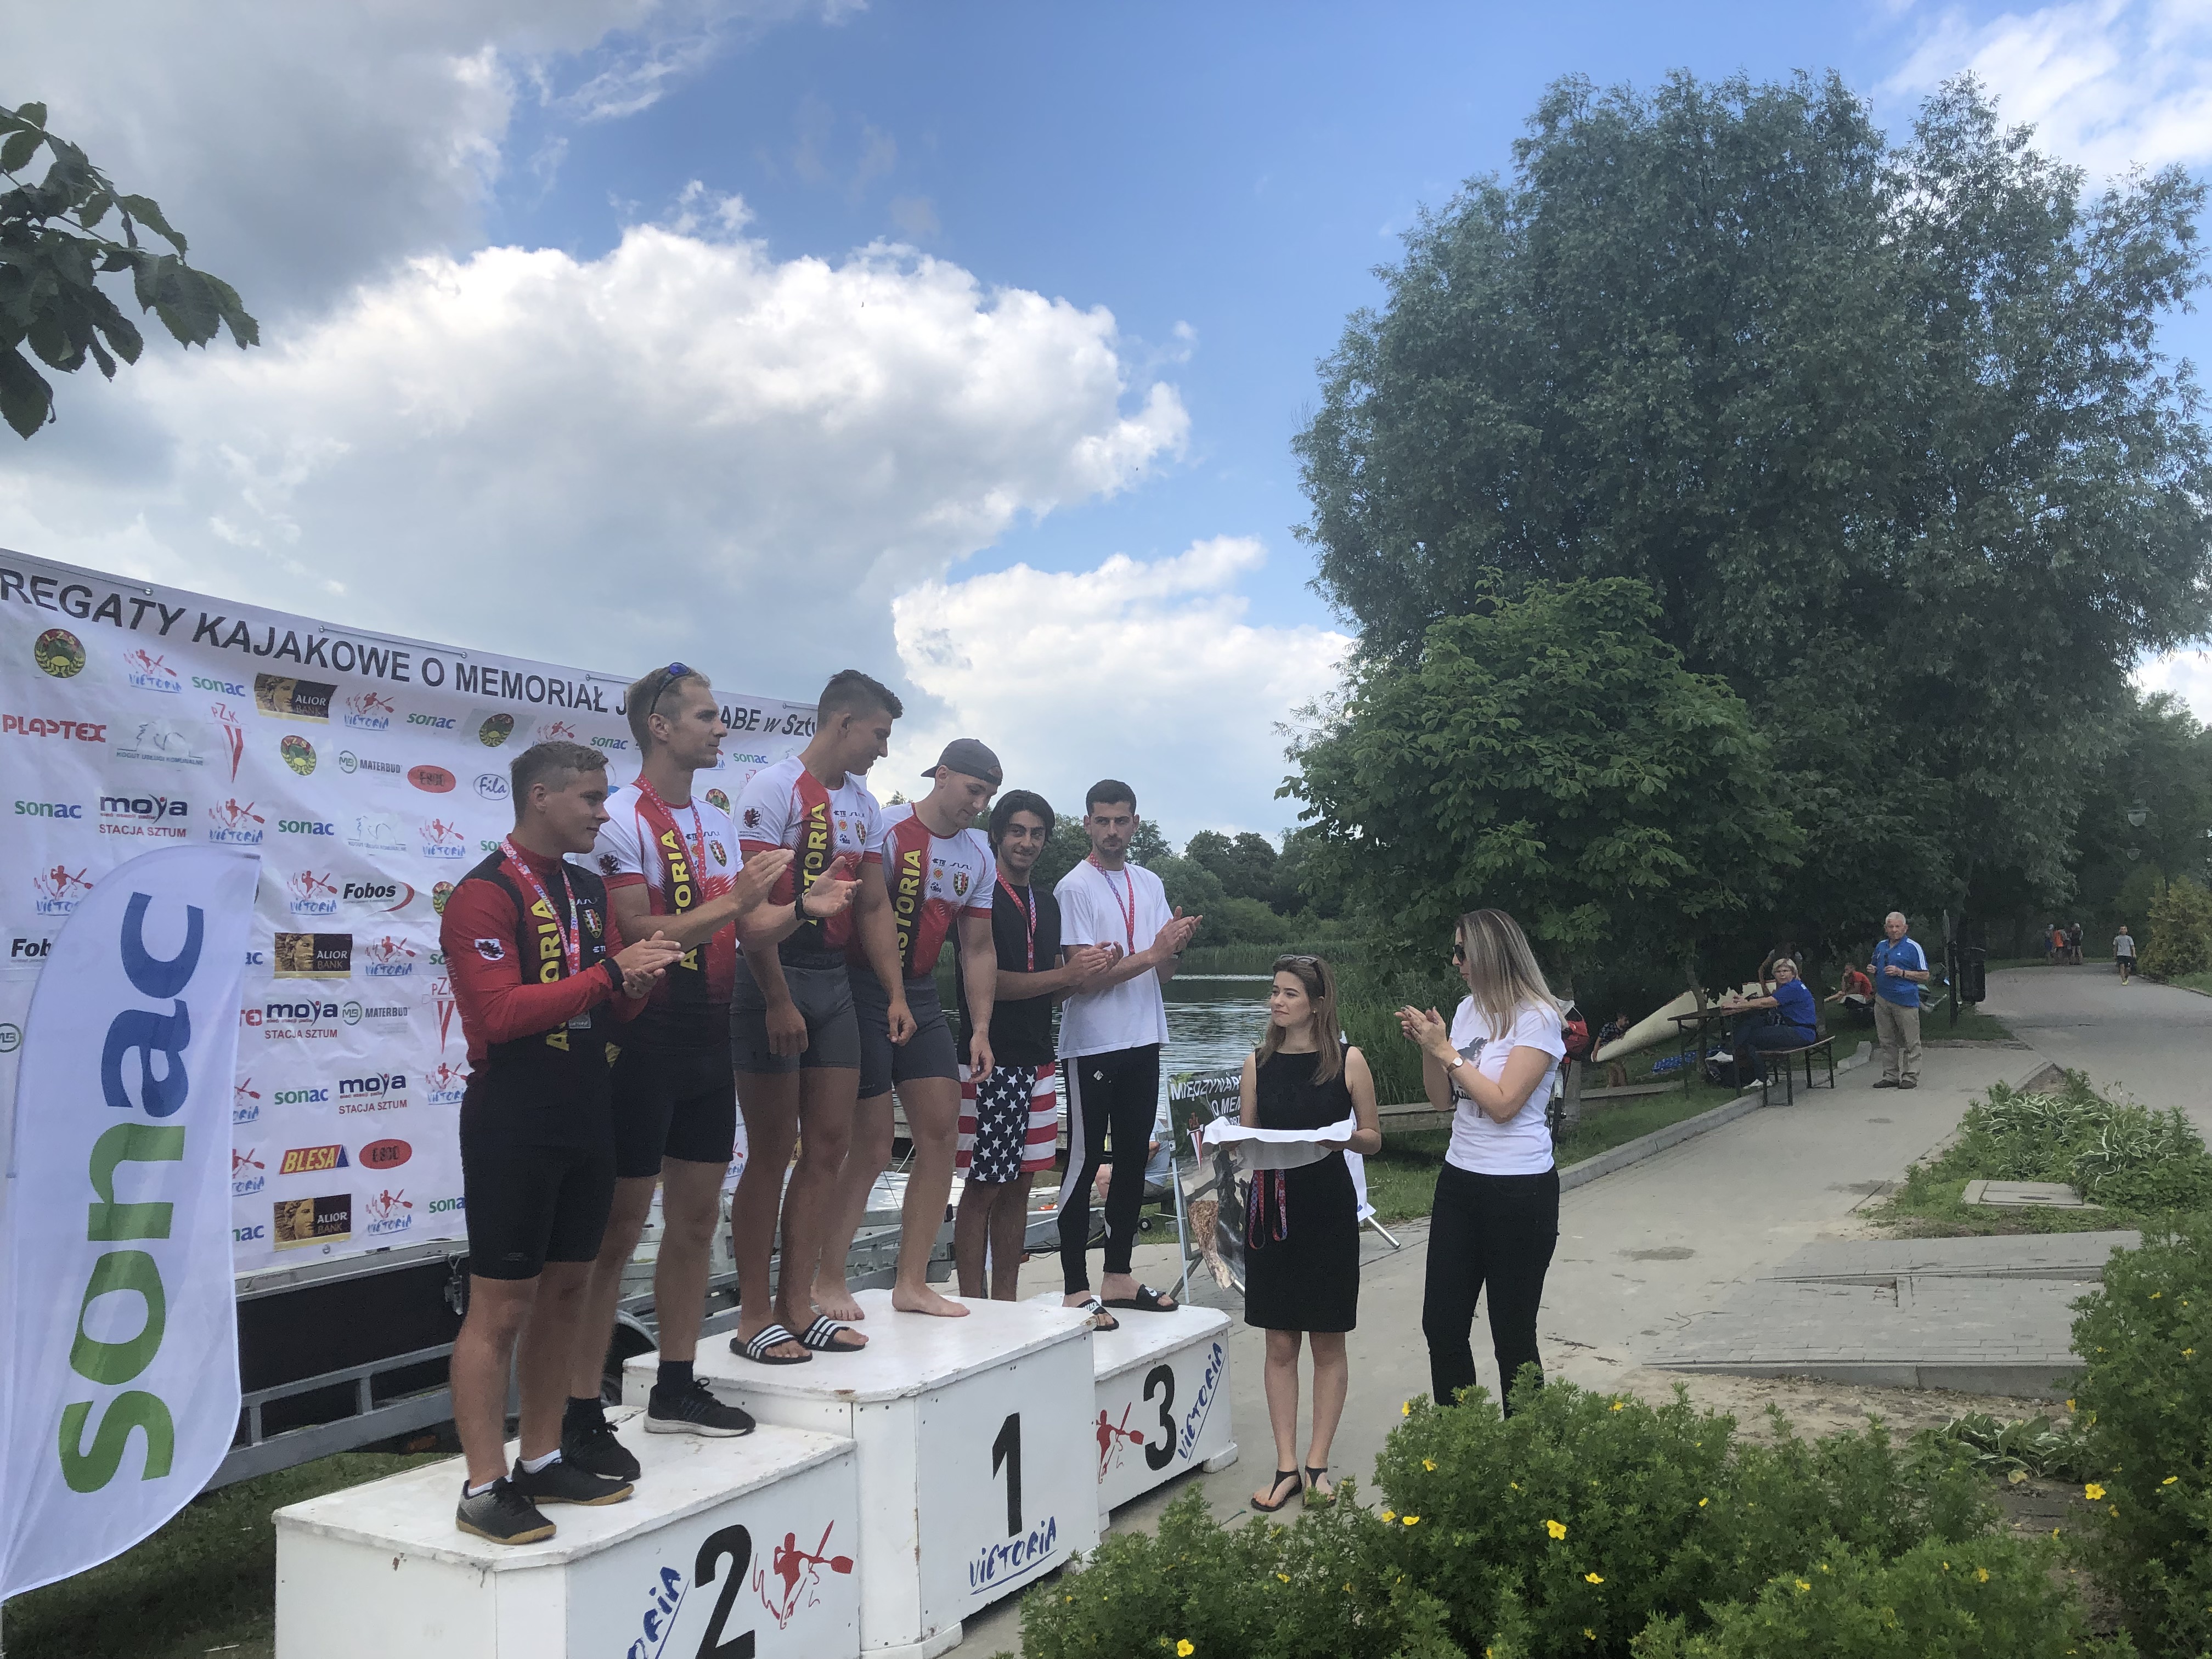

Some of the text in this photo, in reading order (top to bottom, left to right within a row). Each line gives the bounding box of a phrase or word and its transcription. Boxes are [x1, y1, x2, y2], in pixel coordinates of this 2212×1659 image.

[0, 568, 187, 636] REGATY
[192, 613, 410, 682] KAJAKOWE
[421, 657, 445, 687] O
[456, 662, 608, 713] MEMORIAŁ
[192, 676, 246, 697] sonac
[295, 694, 326, 707] ALIOR
[296, 704, 322, 714] BANK
[407, 713, 456, 730] sonac
[763, 717, 782, 732] w
[590, 736, 629, 750] sonac
[360, 759, 402, 774] MATERBUD
[733, 753, 769, 764] sonac
[15, 800, 82, 819] sonac
[100, 794, 188, 824] moya
[99, 824, 187, 838] STACJA SZTUM
[278, 820, 335, 836] sonac
[343, 882, 396, 899] Fobos
[317, 950, 348, 959] ALIOR
[317, 961, 343, 969] BANK
[267, 998, 338, 1026] moya
[365, 1007, 408, 1018] MATERBUD
[265, 1029, 337, 1040] STACJA SZTUM
[339, 1073, 407, 1099] moya
[274, 1088, 329, 1105] sonac
[338, 1099, 407, 1115] STACJA SZTUM
[283, 1147, 335, 1173] BLESA
[58, 891, 204, 1493] sonac
[317, 1211, 348, 1224] ALIOR
[318, 1223, 342, 1234] BANK
[1143, 1364, 1177, 1471] 3
[992, 1412, 1023, 1538] 1
[695, 1524, 755, 1659] 2
